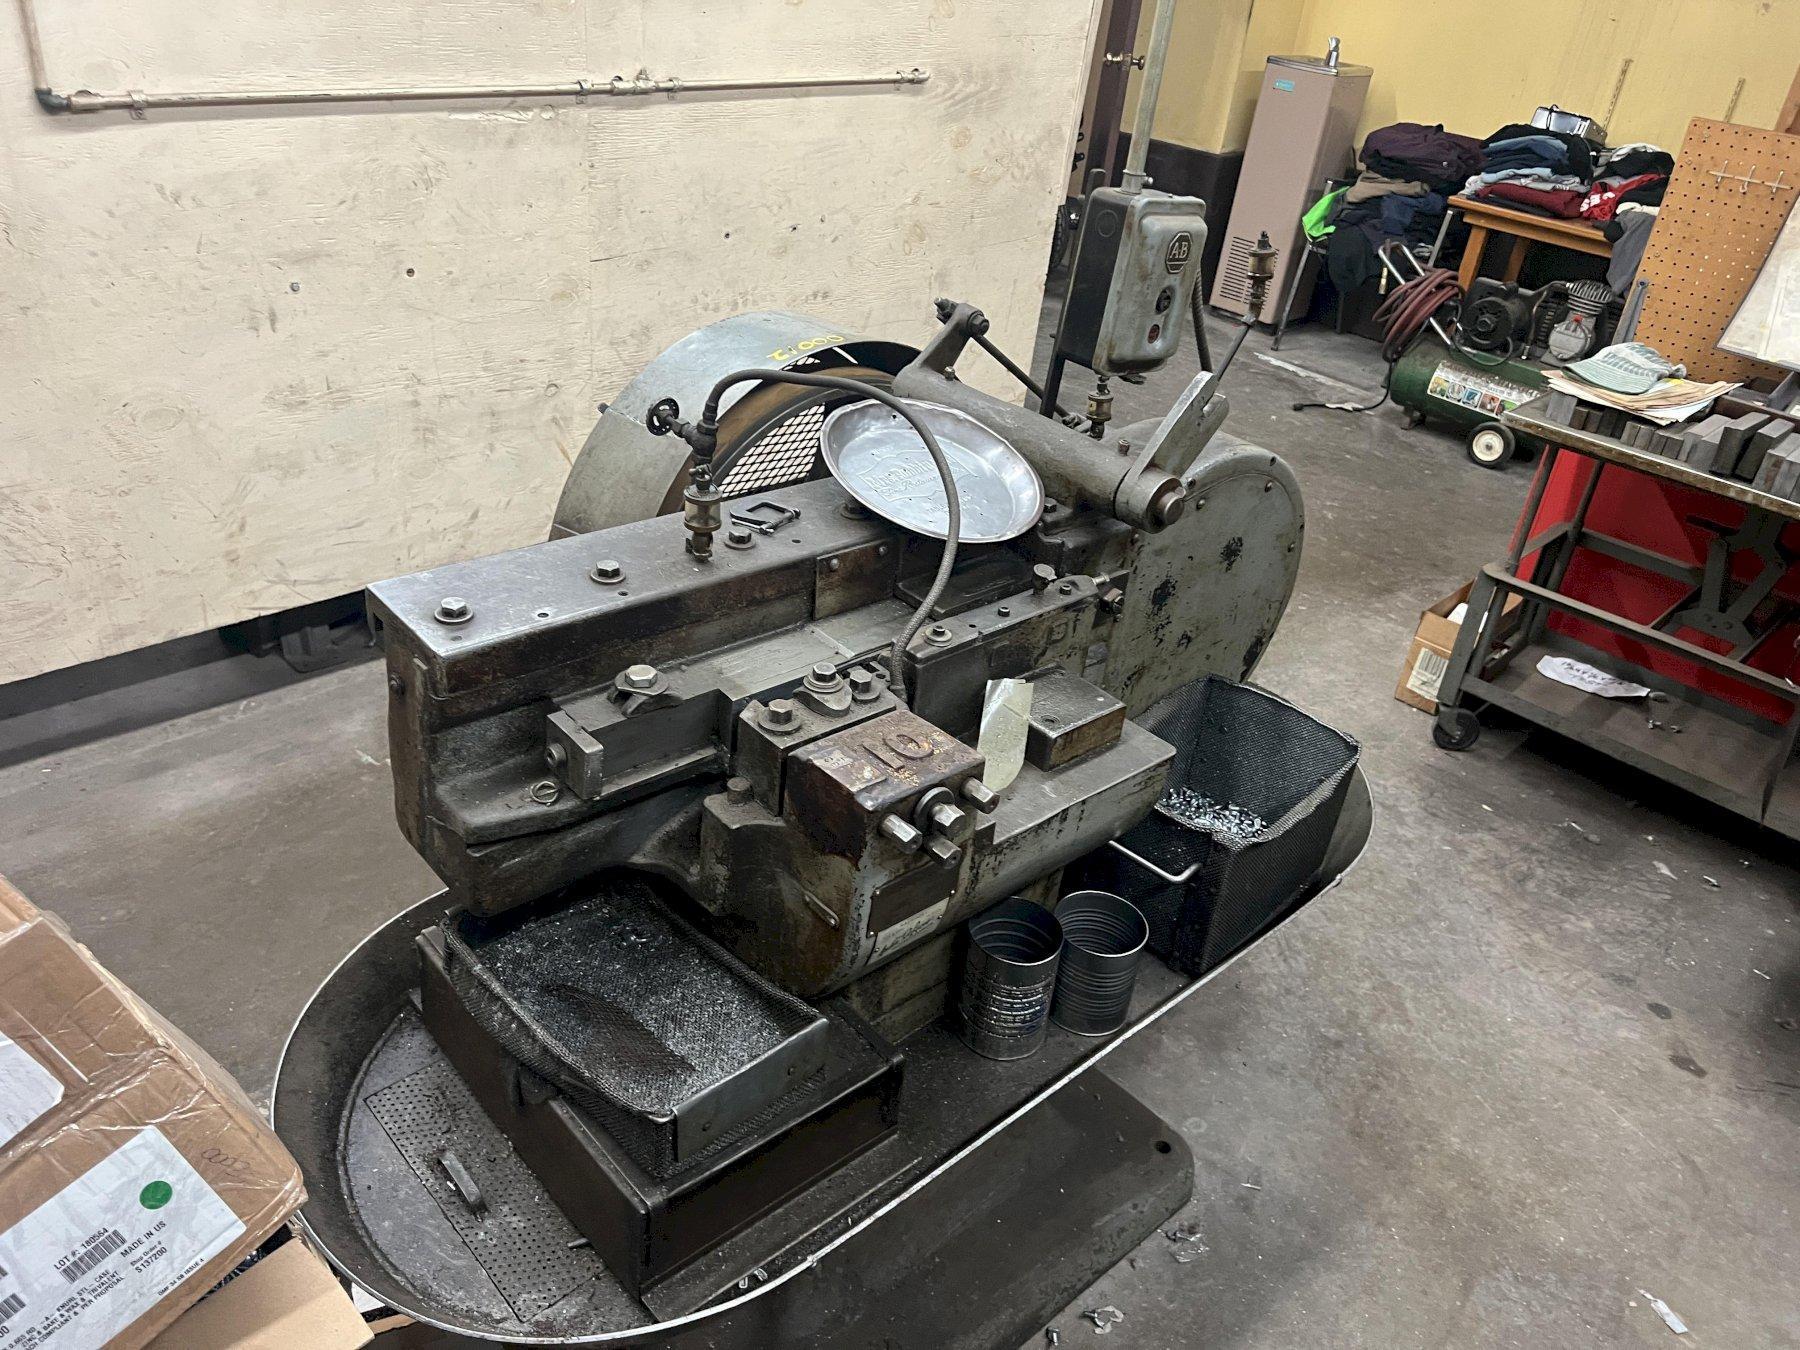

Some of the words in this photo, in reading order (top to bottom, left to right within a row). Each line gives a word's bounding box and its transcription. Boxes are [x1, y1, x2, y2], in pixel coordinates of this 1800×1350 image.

[1169, 241, 1188, 259] AB
[862, 733, 935, 771] 10
[120, 1237, 145, 1258] MADE
[143, 1230, 154, 1240] IN
[153, 1220, 167, 1232] US
[53, 1255, 71, 1270] LOT
